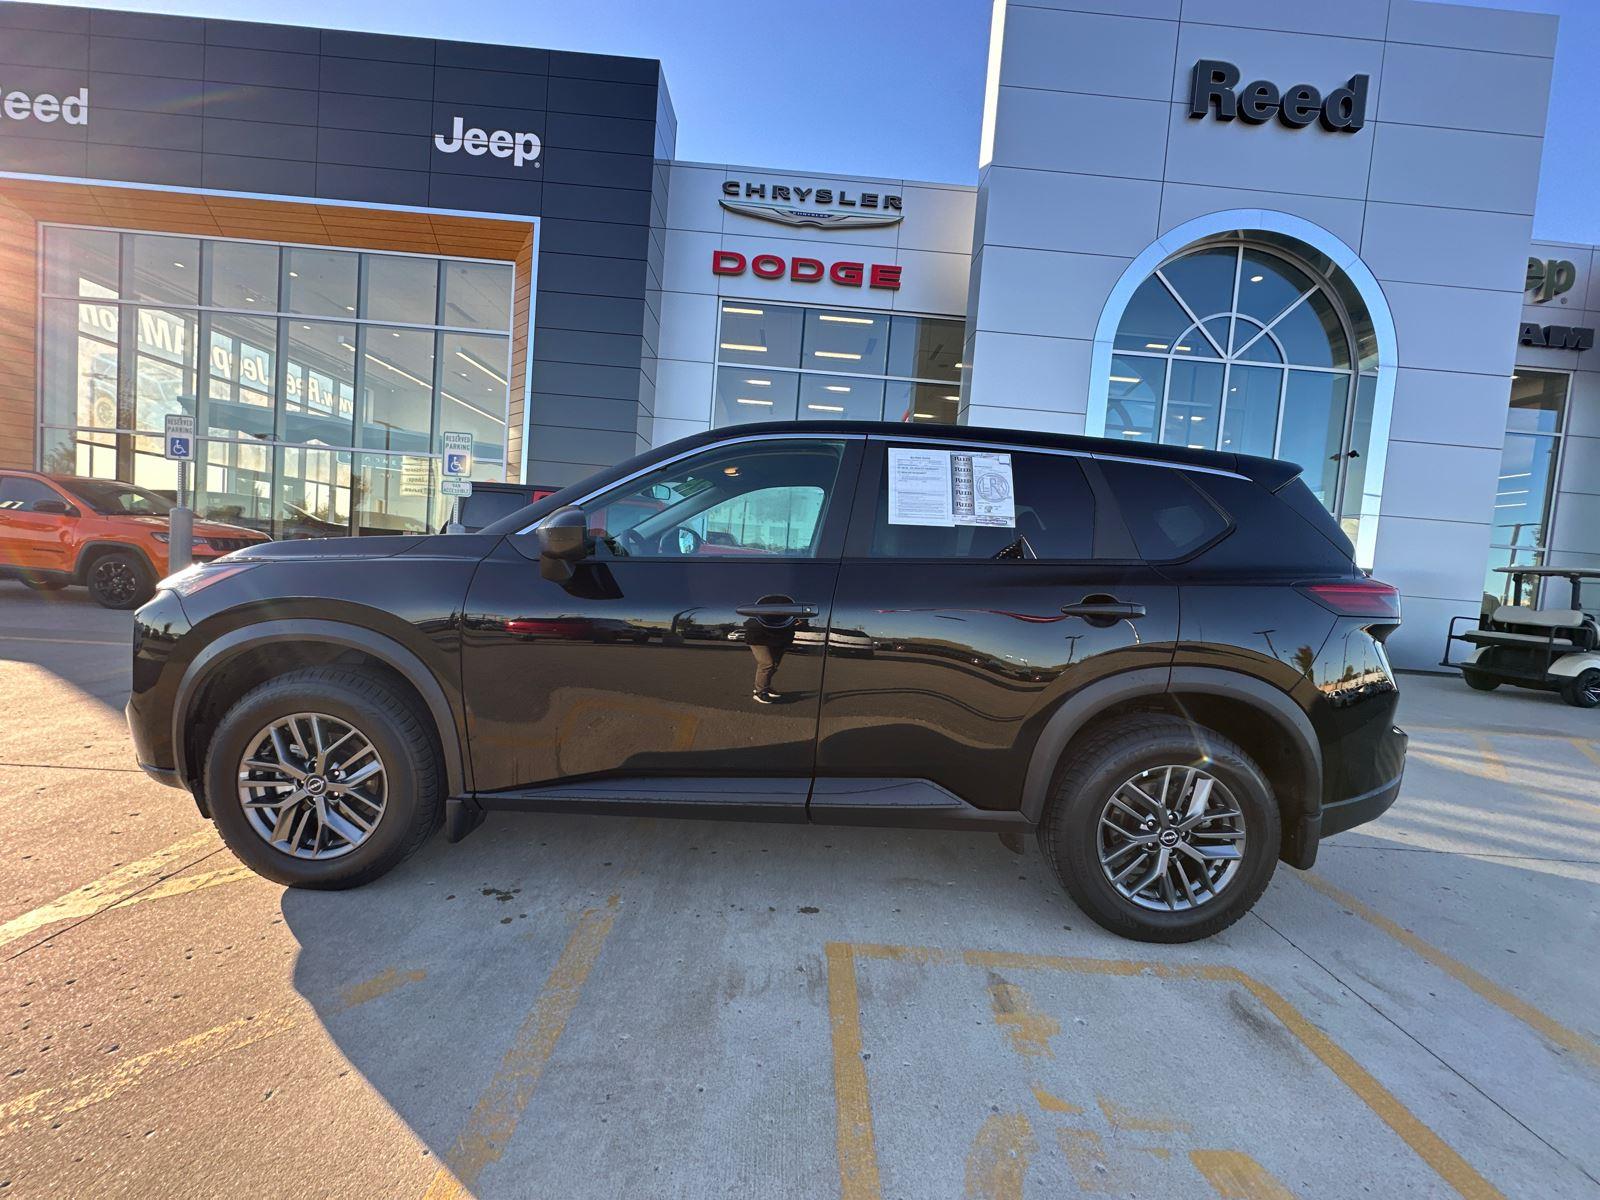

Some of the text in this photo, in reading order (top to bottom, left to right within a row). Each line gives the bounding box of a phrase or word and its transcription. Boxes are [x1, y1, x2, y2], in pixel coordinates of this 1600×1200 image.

[0, 87, 88, 125] eed
[1189, 58, 1370, 133] Reed
[435, 117, 541, 167] Jeep
[722, 181, 903, 210] CHRYSLER
[713, 250, 903, 290] DODGE
[1524, 257, 1576, 304] ep
[1518, 322, 1595, 351] AM
[445, 443, 470, 451] PARKING
